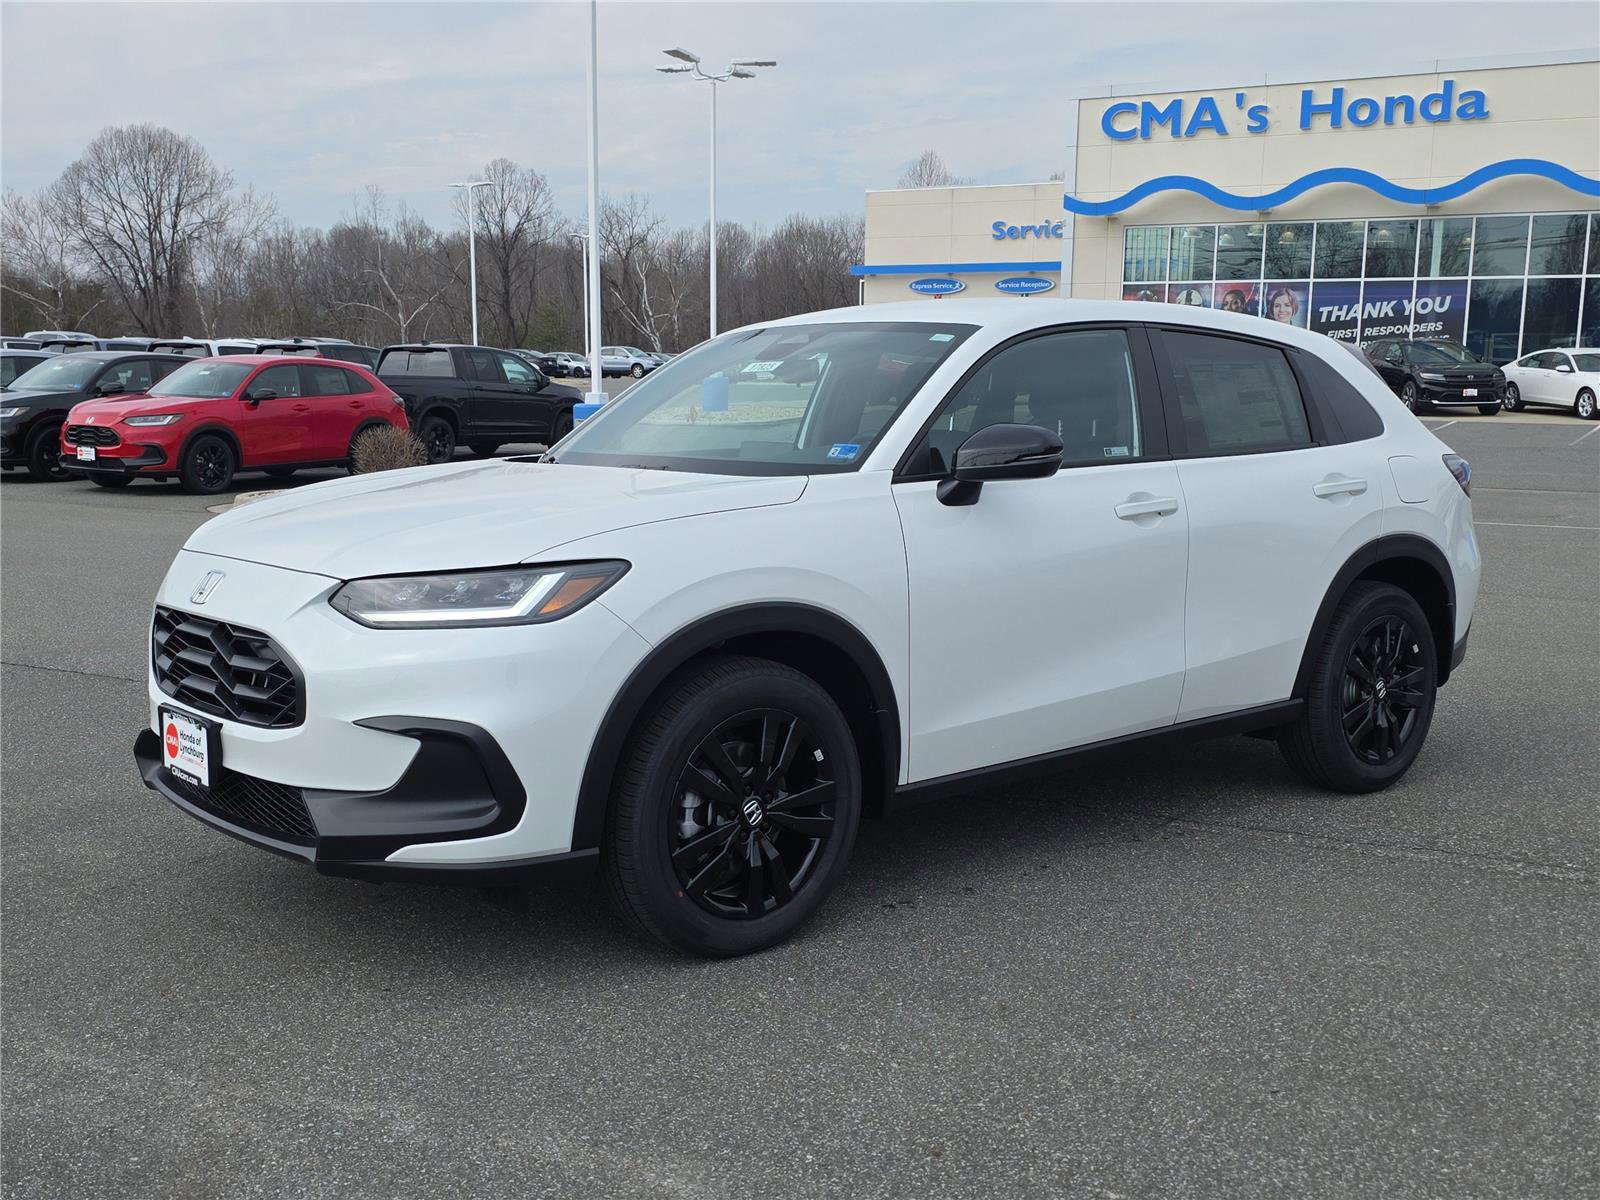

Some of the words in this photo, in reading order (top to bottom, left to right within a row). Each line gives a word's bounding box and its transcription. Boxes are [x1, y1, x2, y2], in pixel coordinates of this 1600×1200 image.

[1101, 93, 1269, 140] CMA's
[1299, 80, 1489, 130] Honda
[911, 283, 933, 291] Express
[933, 282, 954, 290] Service
[997, 281, 1020, 289] Service
[1020, 280, 1051, 289] Reception
[1318, 300, 1398, 323] THANK
[1402, 295, 1452, 316] YOU
[1327, 329, 1359, 341] FIRST
[1364, 322, 1443, 337] RESPONDERS
[180, 731, 196, 744] Honda
[195, 737, 202, 746] of
[180, 743, 204, 762] Lynchburg
